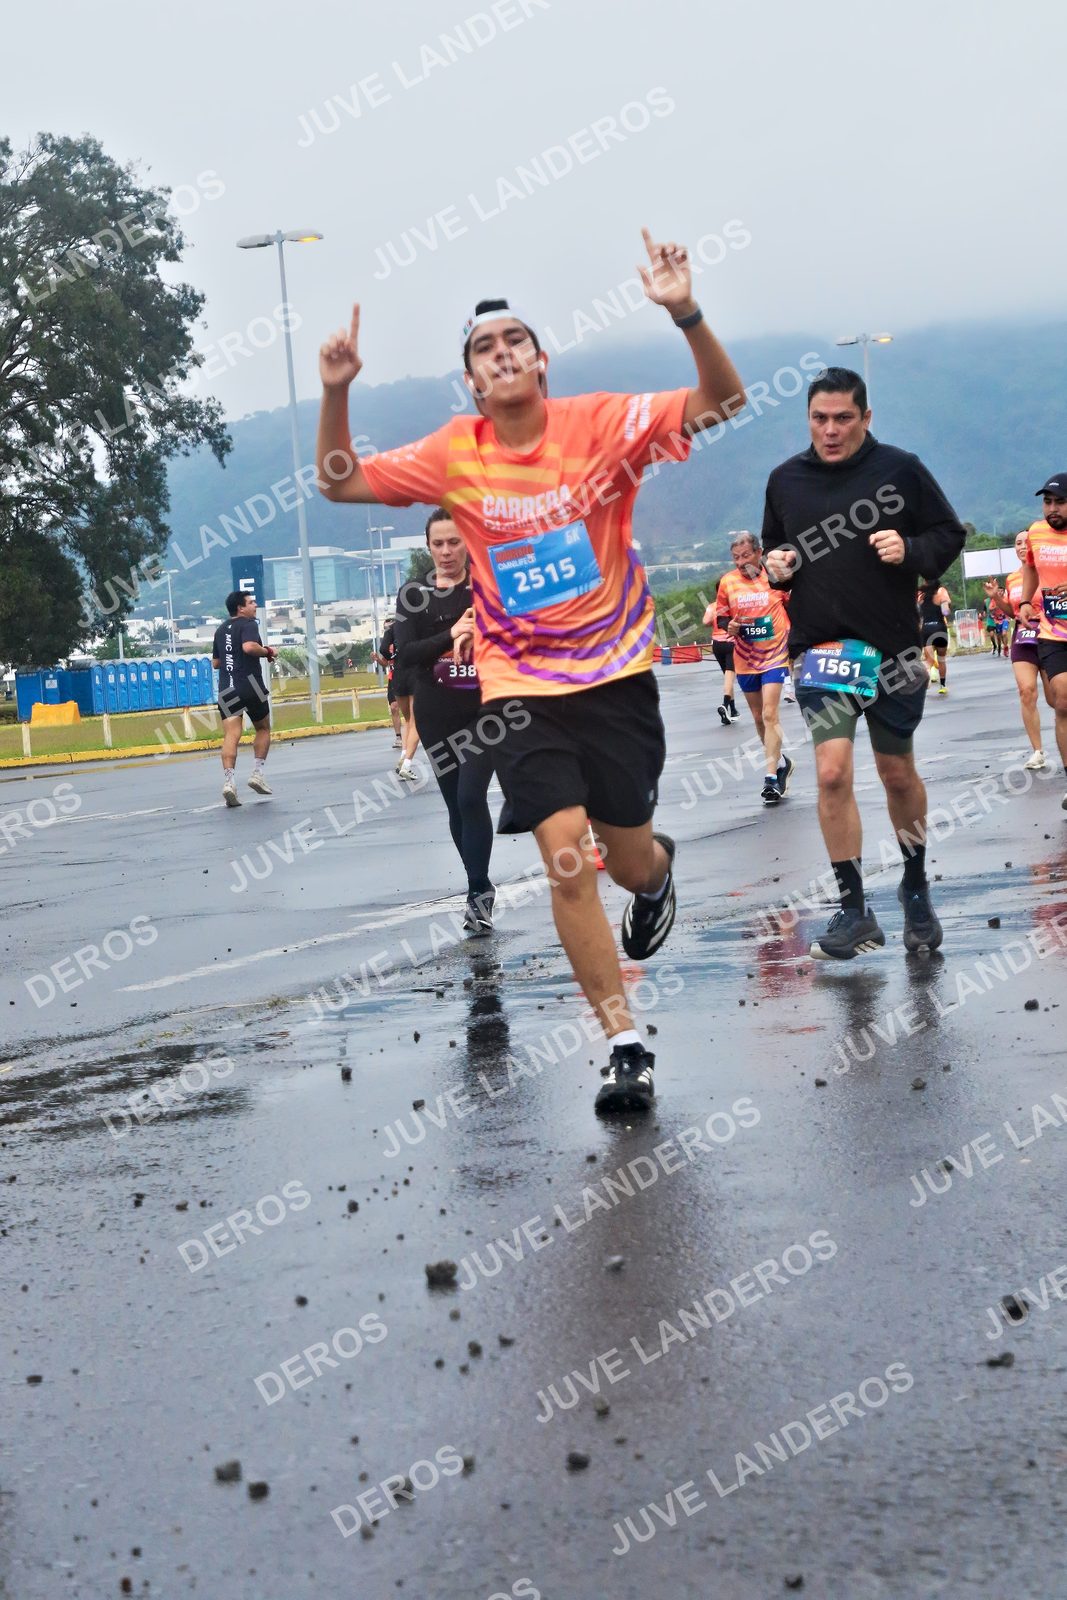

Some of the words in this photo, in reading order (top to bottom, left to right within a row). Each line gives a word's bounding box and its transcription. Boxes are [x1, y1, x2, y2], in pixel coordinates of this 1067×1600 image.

[513, 557, 576, 593] 2515
[745, 626, 767, 635] 1596
[225, 633, 233, 651] MIC
[225, 653, 234, 671] MIC
[449, 665, 477, 677] 338
[816, 658, 861, 678] 1561
